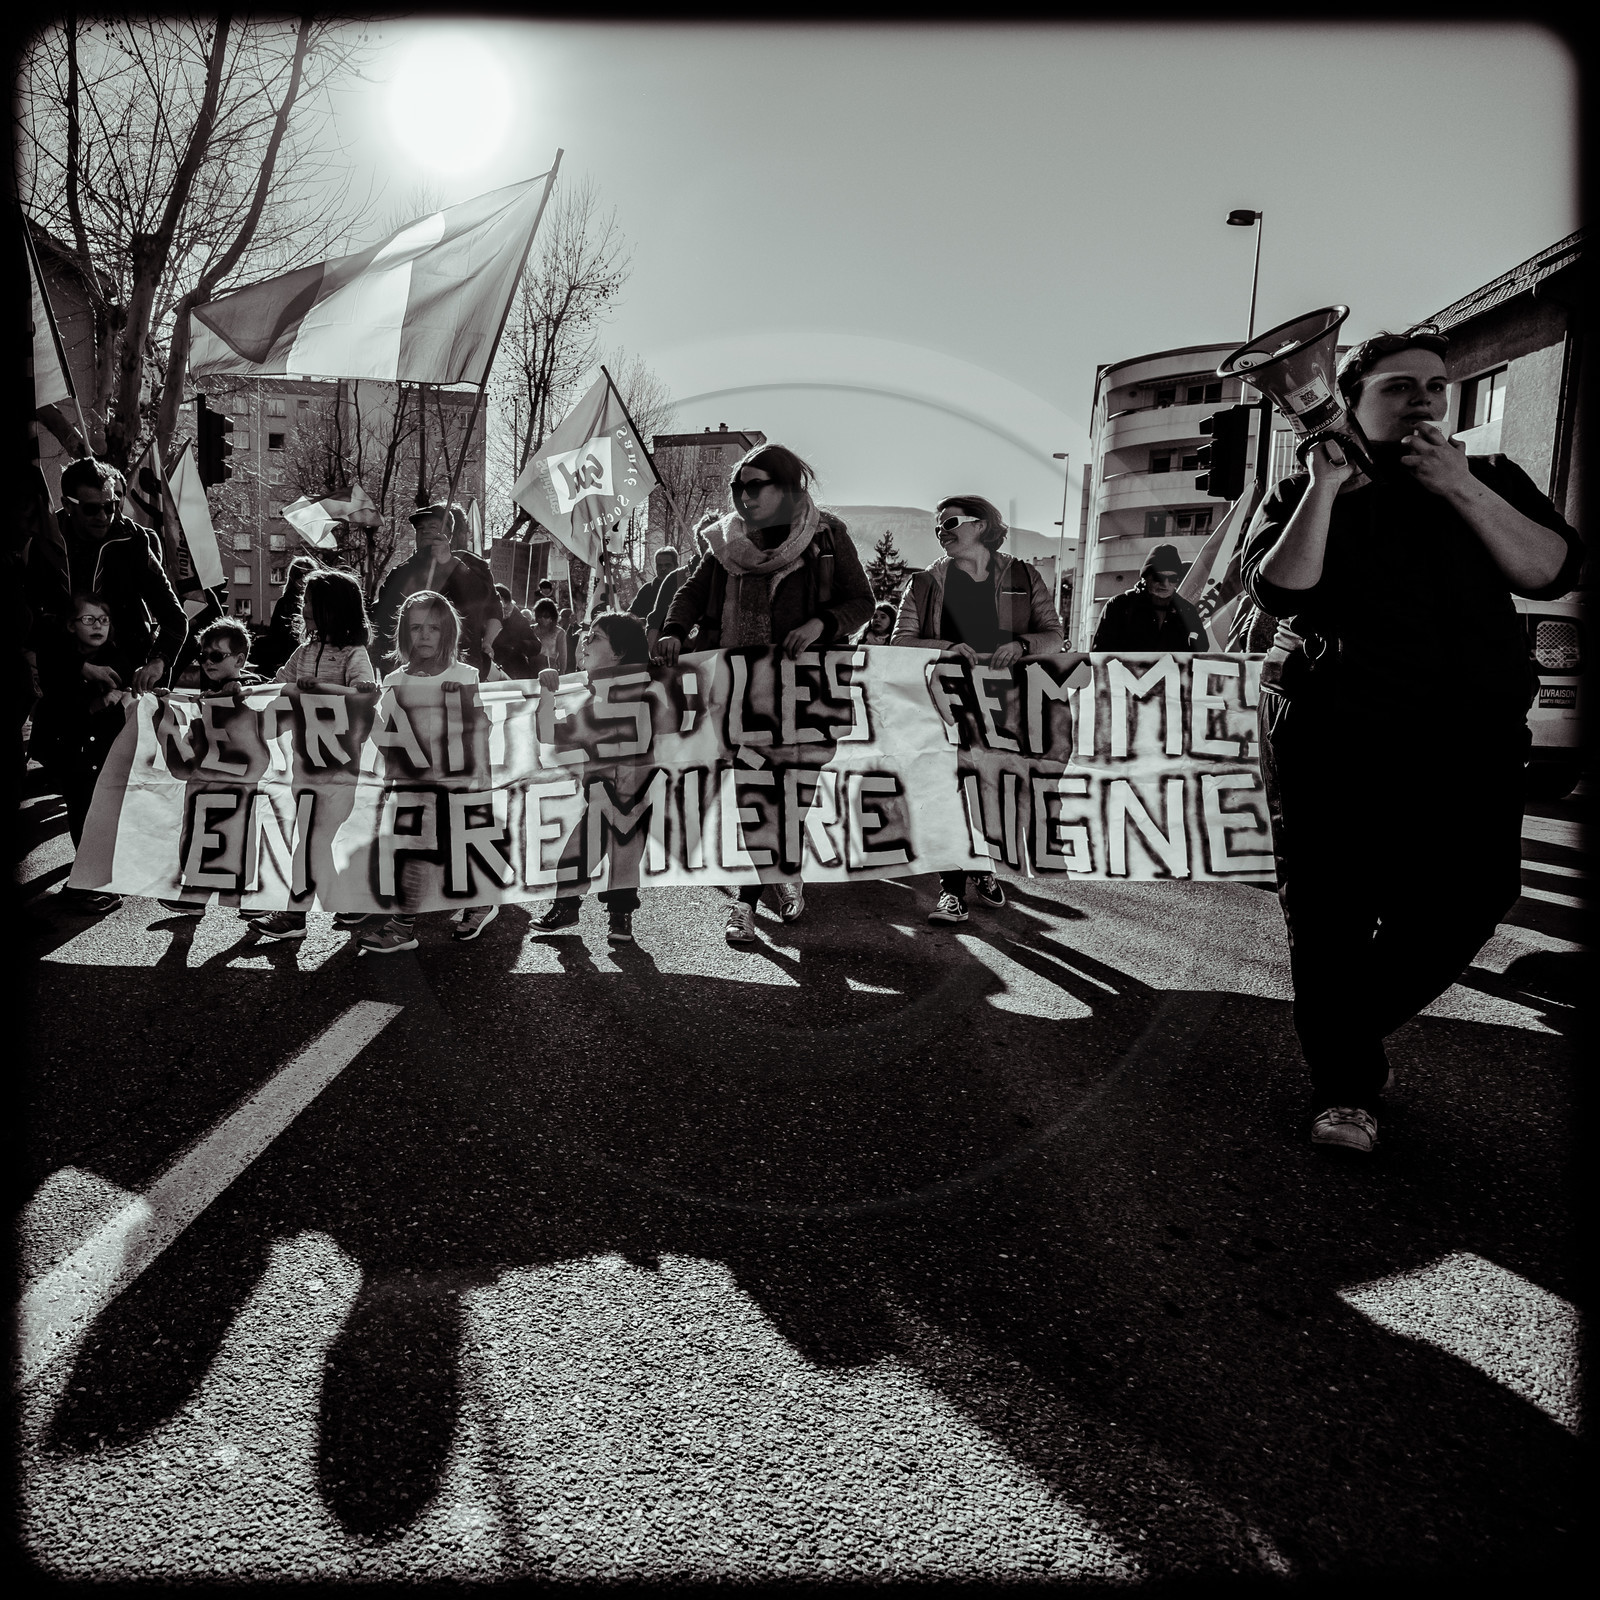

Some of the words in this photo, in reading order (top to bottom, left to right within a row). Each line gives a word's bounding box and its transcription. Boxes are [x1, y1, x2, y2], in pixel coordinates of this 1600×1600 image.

[152, 671, 652, 776] RETRAITES
[729, 652, 870, 745] LES
[1540, 688, 1576, 698] LIVRAISON
[182, 792, 315, 895] EN
[378, 744, 910, 896] PREMIÈRE
[962, 772, 1276, 878] LIGNE
